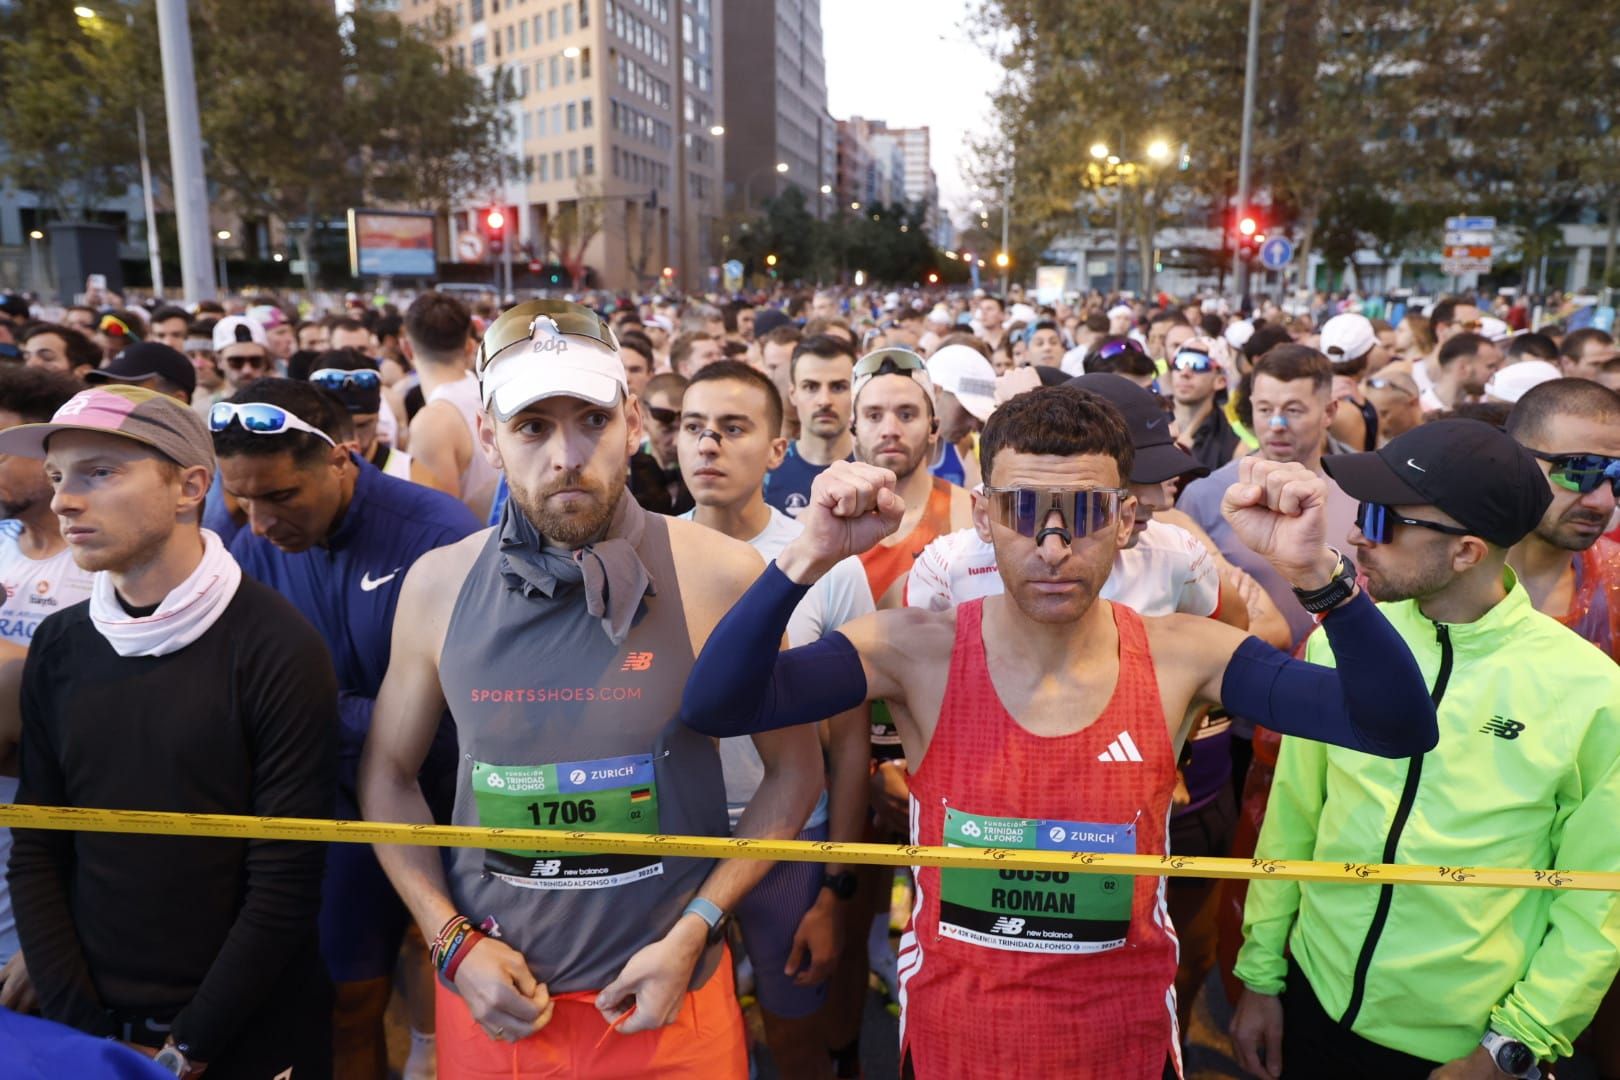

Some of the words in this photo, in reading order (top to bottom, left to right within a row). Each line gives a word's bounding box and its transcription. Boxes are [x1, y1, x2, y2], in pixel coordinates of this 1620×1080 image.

[534, 336, 568, 355] edp
[471, 687, 641, 702] SPORTSSHOES.COM
[591, 766, 634, 780] ZURICH
[506, 775, 545, 784] TRINIDAD
[507, 783, 545, 791] ALFONSO
[527, 799, 597, 826] 1706
[983, 827, 1024, 836] TRINIDAD
[983, 834, 1024, 843] ALFONSO
[1071, 832, 1115, 843] ZURICH
[564, 868, 578, 876] new
[579, 867, 609, 876] balance
[539, 879, 573, 888] TRINIDAD
[574, 879, 609, 887] ALFONSO
[1104, 881, 1115, 890] 02
[991, 888, 1076, 914] ROMAN
[1042, 929, 1073, 939] balance
[998, 938, 1035, 948] TRINIDAD
[1035, 941, 1072, 950] ALFONSO
